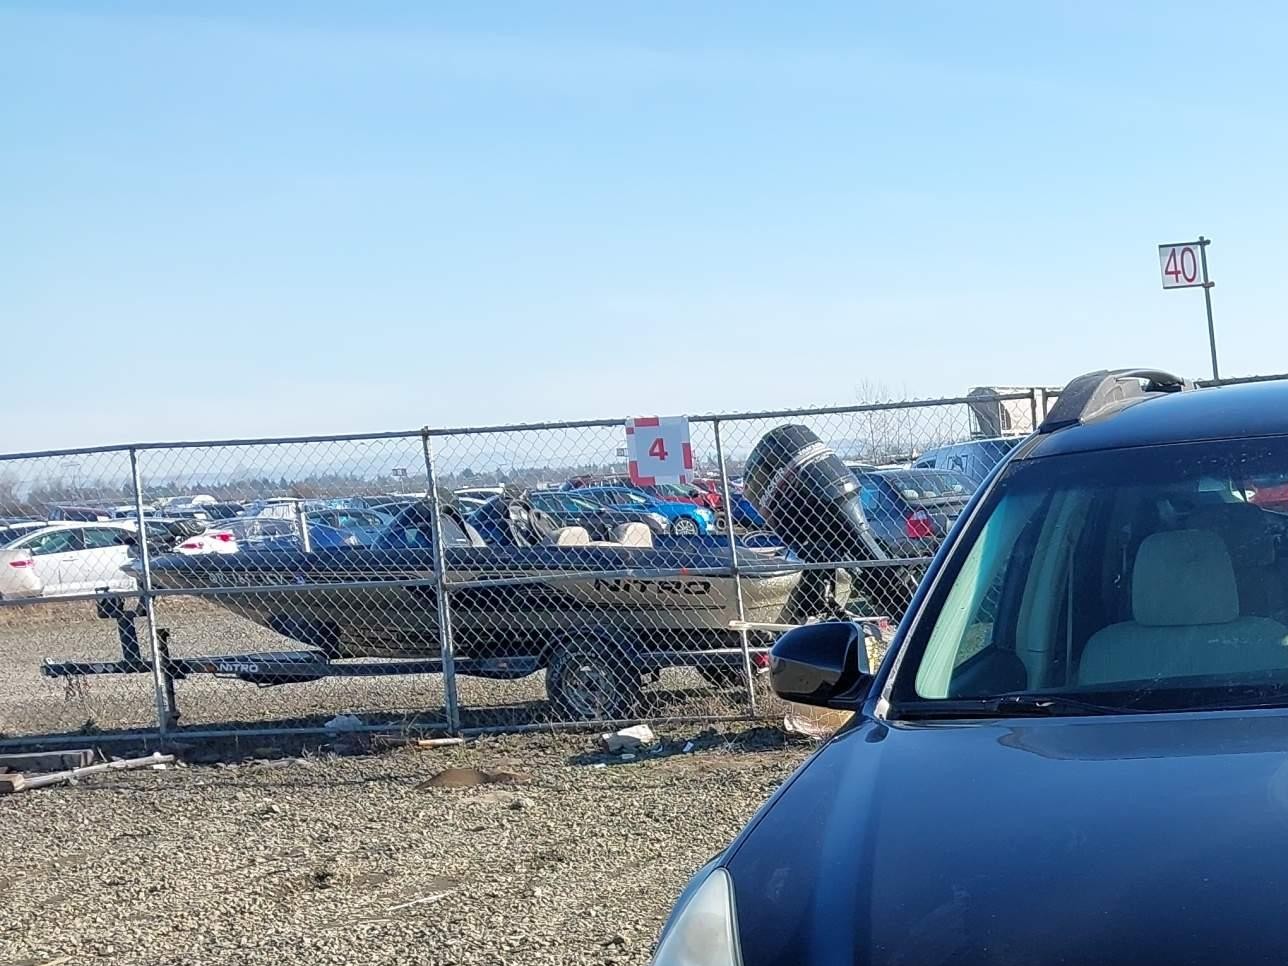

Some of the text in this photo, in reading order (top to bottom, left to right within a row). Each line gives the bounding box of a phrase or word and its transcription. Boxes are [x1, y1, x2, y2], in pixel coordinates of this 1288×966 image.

[1164, 246, 1198, 284] 40
[648, 437, 669, 461] 4
[594, 577, 712, 595] NITRO
[219, 663, 259, 673] NITRO
